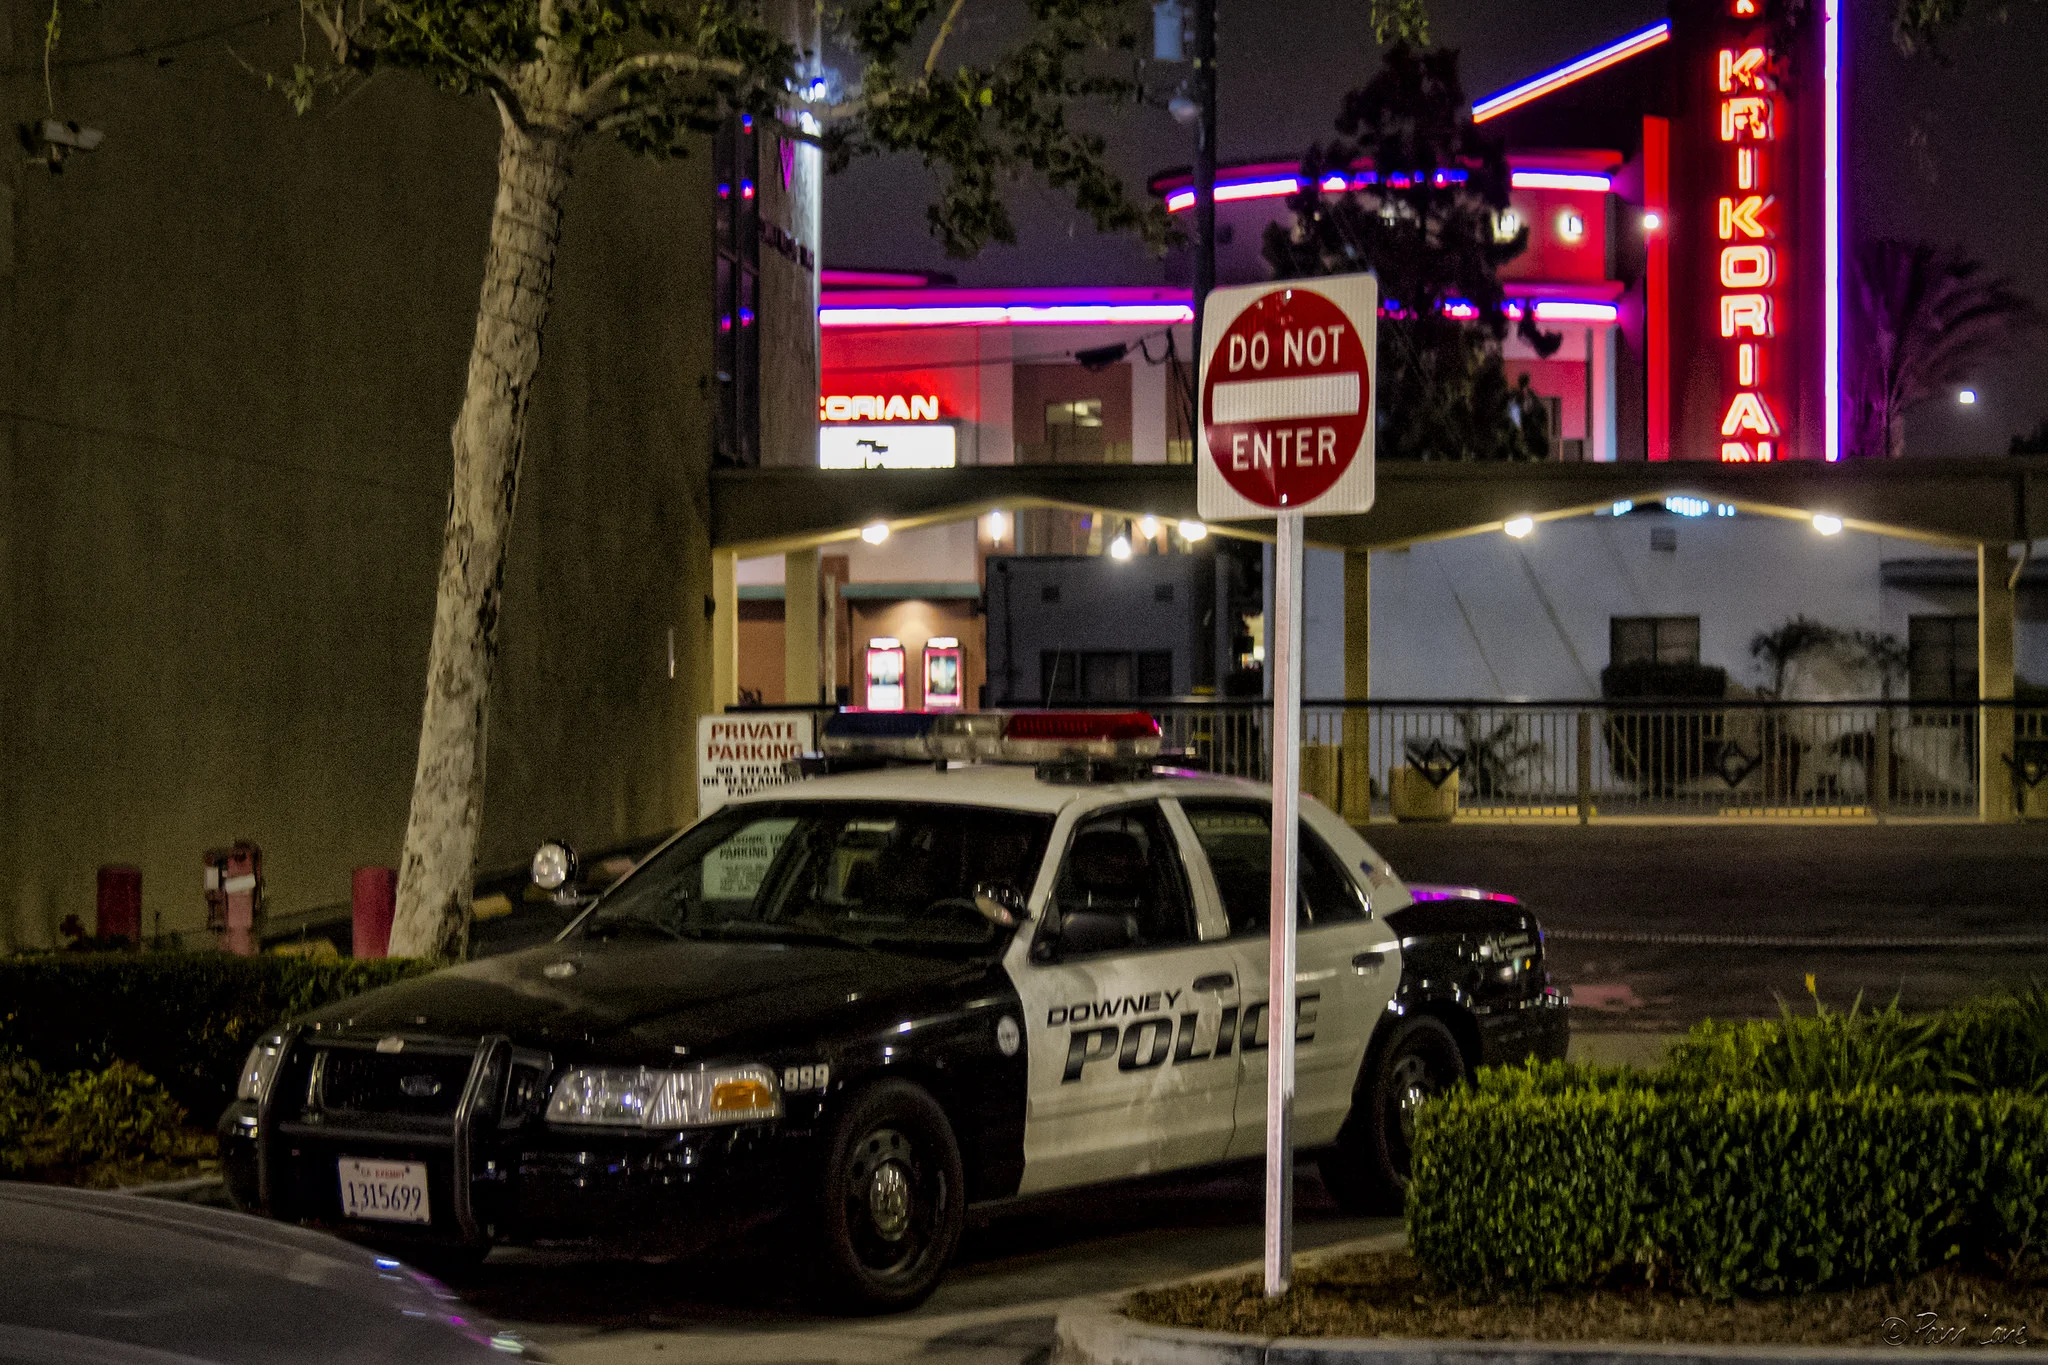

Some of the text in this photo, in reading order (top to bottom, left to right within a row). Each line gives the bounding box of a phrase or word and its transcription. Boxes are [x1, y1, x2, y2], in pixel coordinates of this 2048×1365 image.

[1228, 324, 1345, 373] DO NOT
[1232, 426, 1337, 472] ENTER
[711, 721, 797, 740] PRIVATE
[707, 743, 803, 761] PARKING
[716, 766, 733, 777] NO
[1047, 988, 1182, 1028] DOWNEY
[1061, 992, 1321, 1086] POLICE
[784, 1063, 830, 1092] 899
[348, 1181, 421, 1212] 1315699
